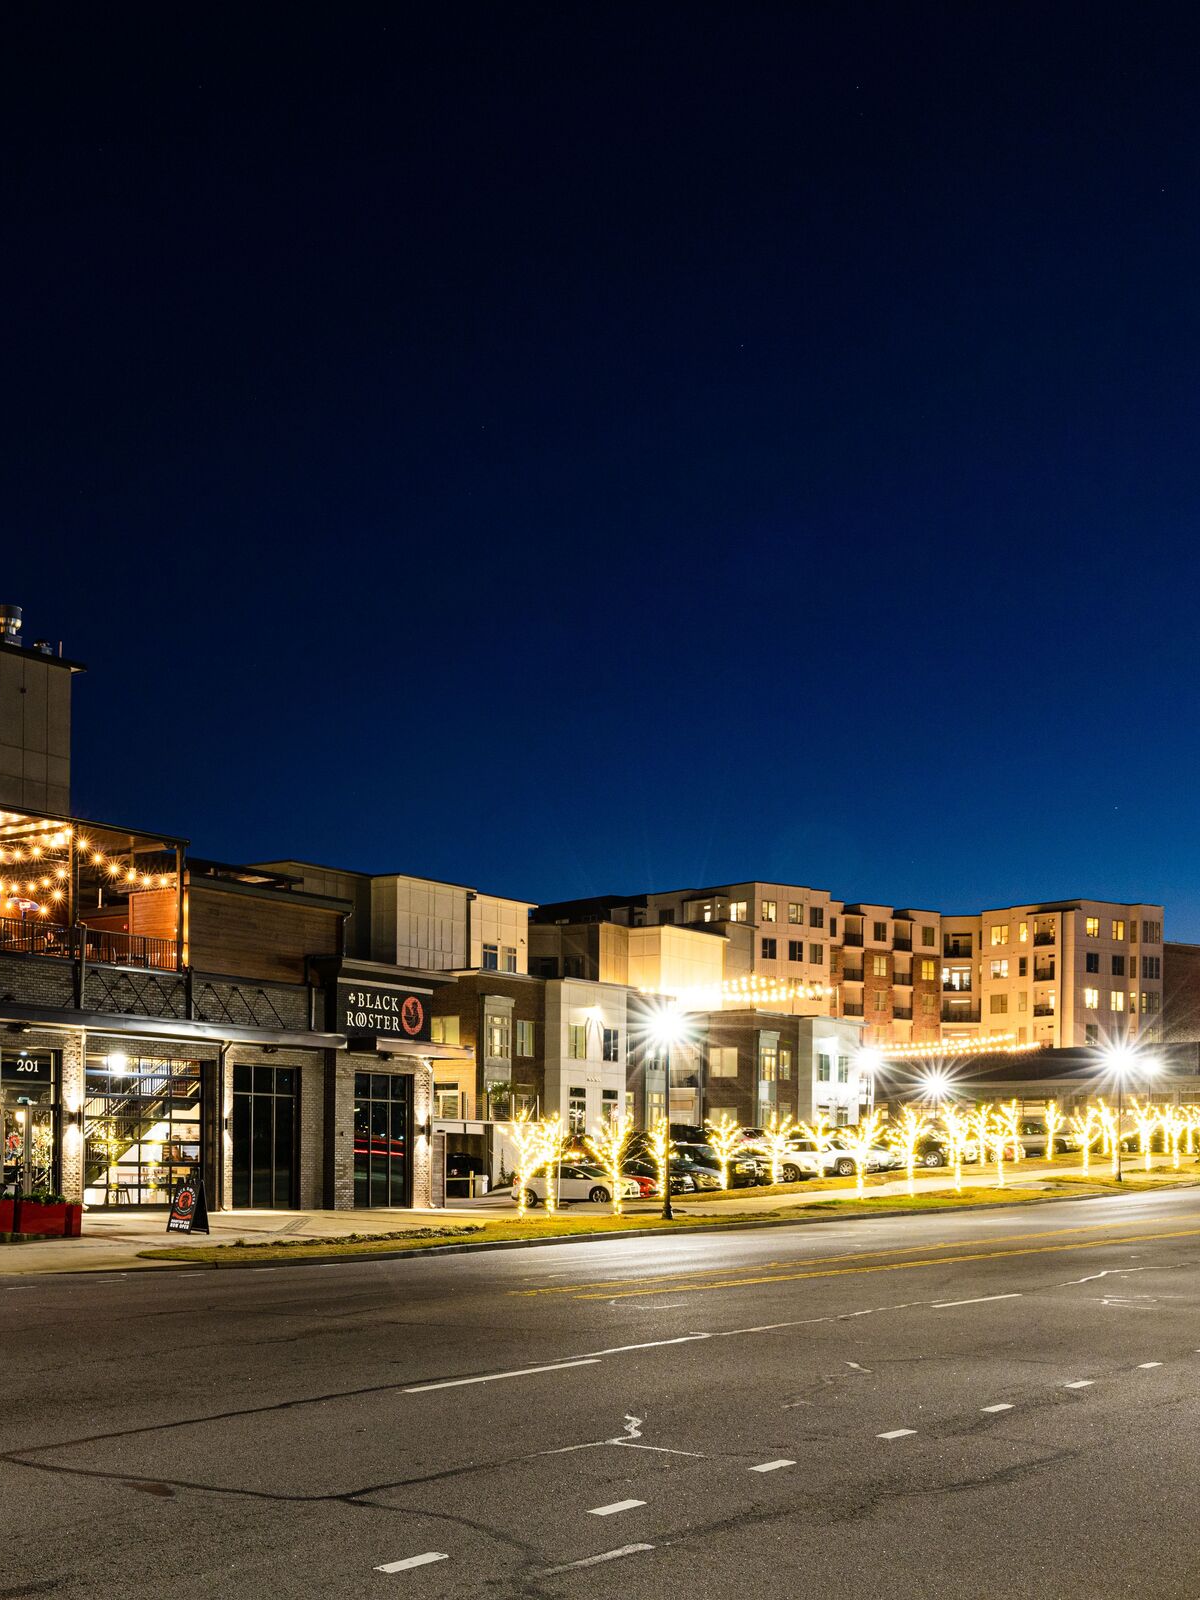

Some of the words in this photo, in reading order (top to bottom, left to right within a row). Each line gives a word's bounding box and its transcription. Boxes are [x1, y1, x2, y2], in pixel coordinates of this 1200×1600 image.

[357, 992, 399, 1012] BLACK
[346, 1011, 400, 1031] ROOSTER
[16, 1059, 39, 1072] 201
